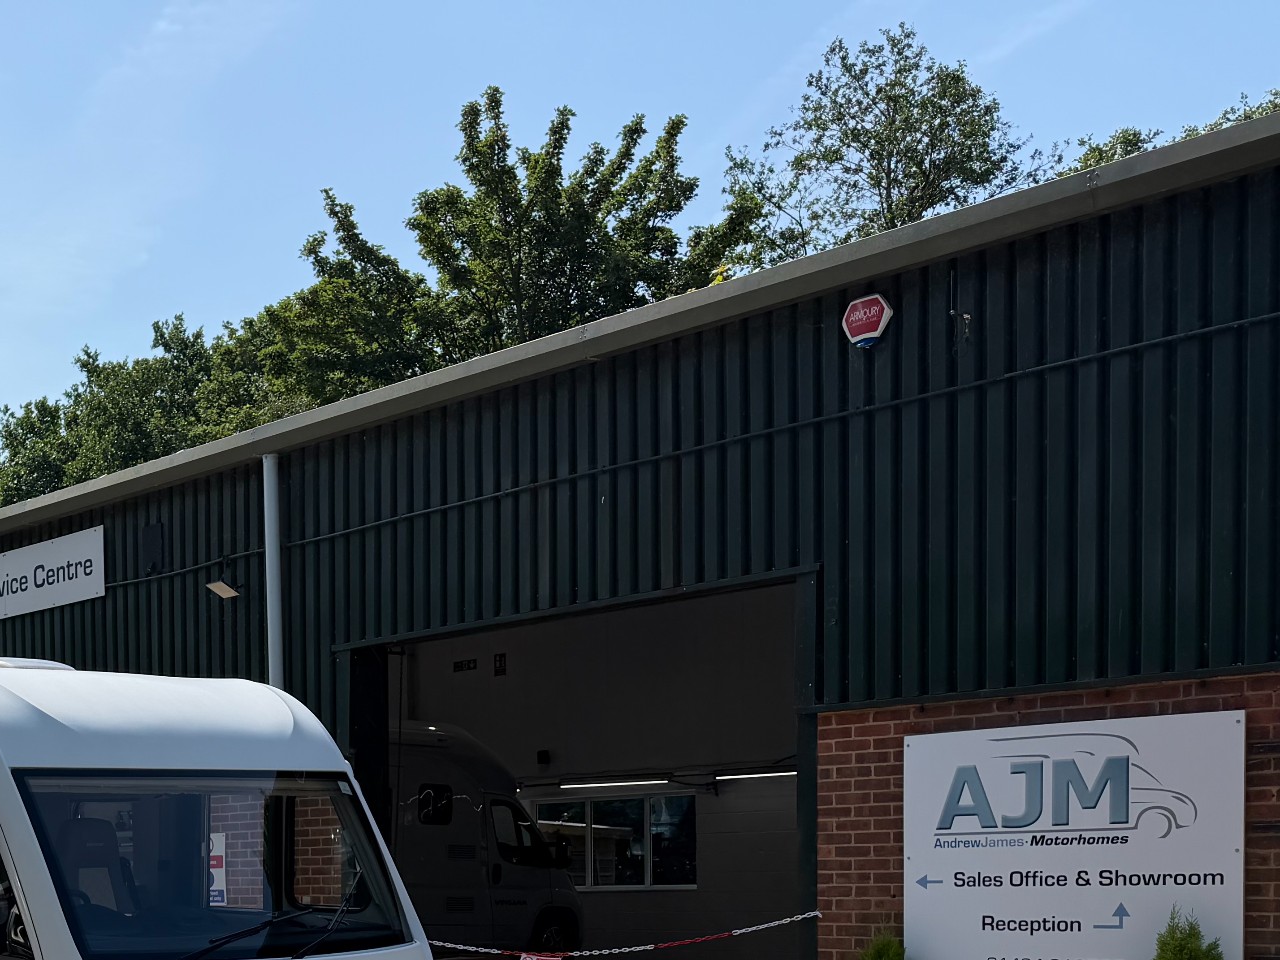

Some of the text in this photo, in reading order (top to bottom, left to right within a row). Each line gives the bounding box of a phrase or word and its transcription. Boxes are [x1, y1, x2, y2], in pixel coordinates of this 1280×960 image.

[33, 558, 93, 589] Centre
[936, 755, 1129, 830] AJM
[953, 869, 1225, 887] Sales Office & Showroom
[981, 915, 1082, 935] Reception
